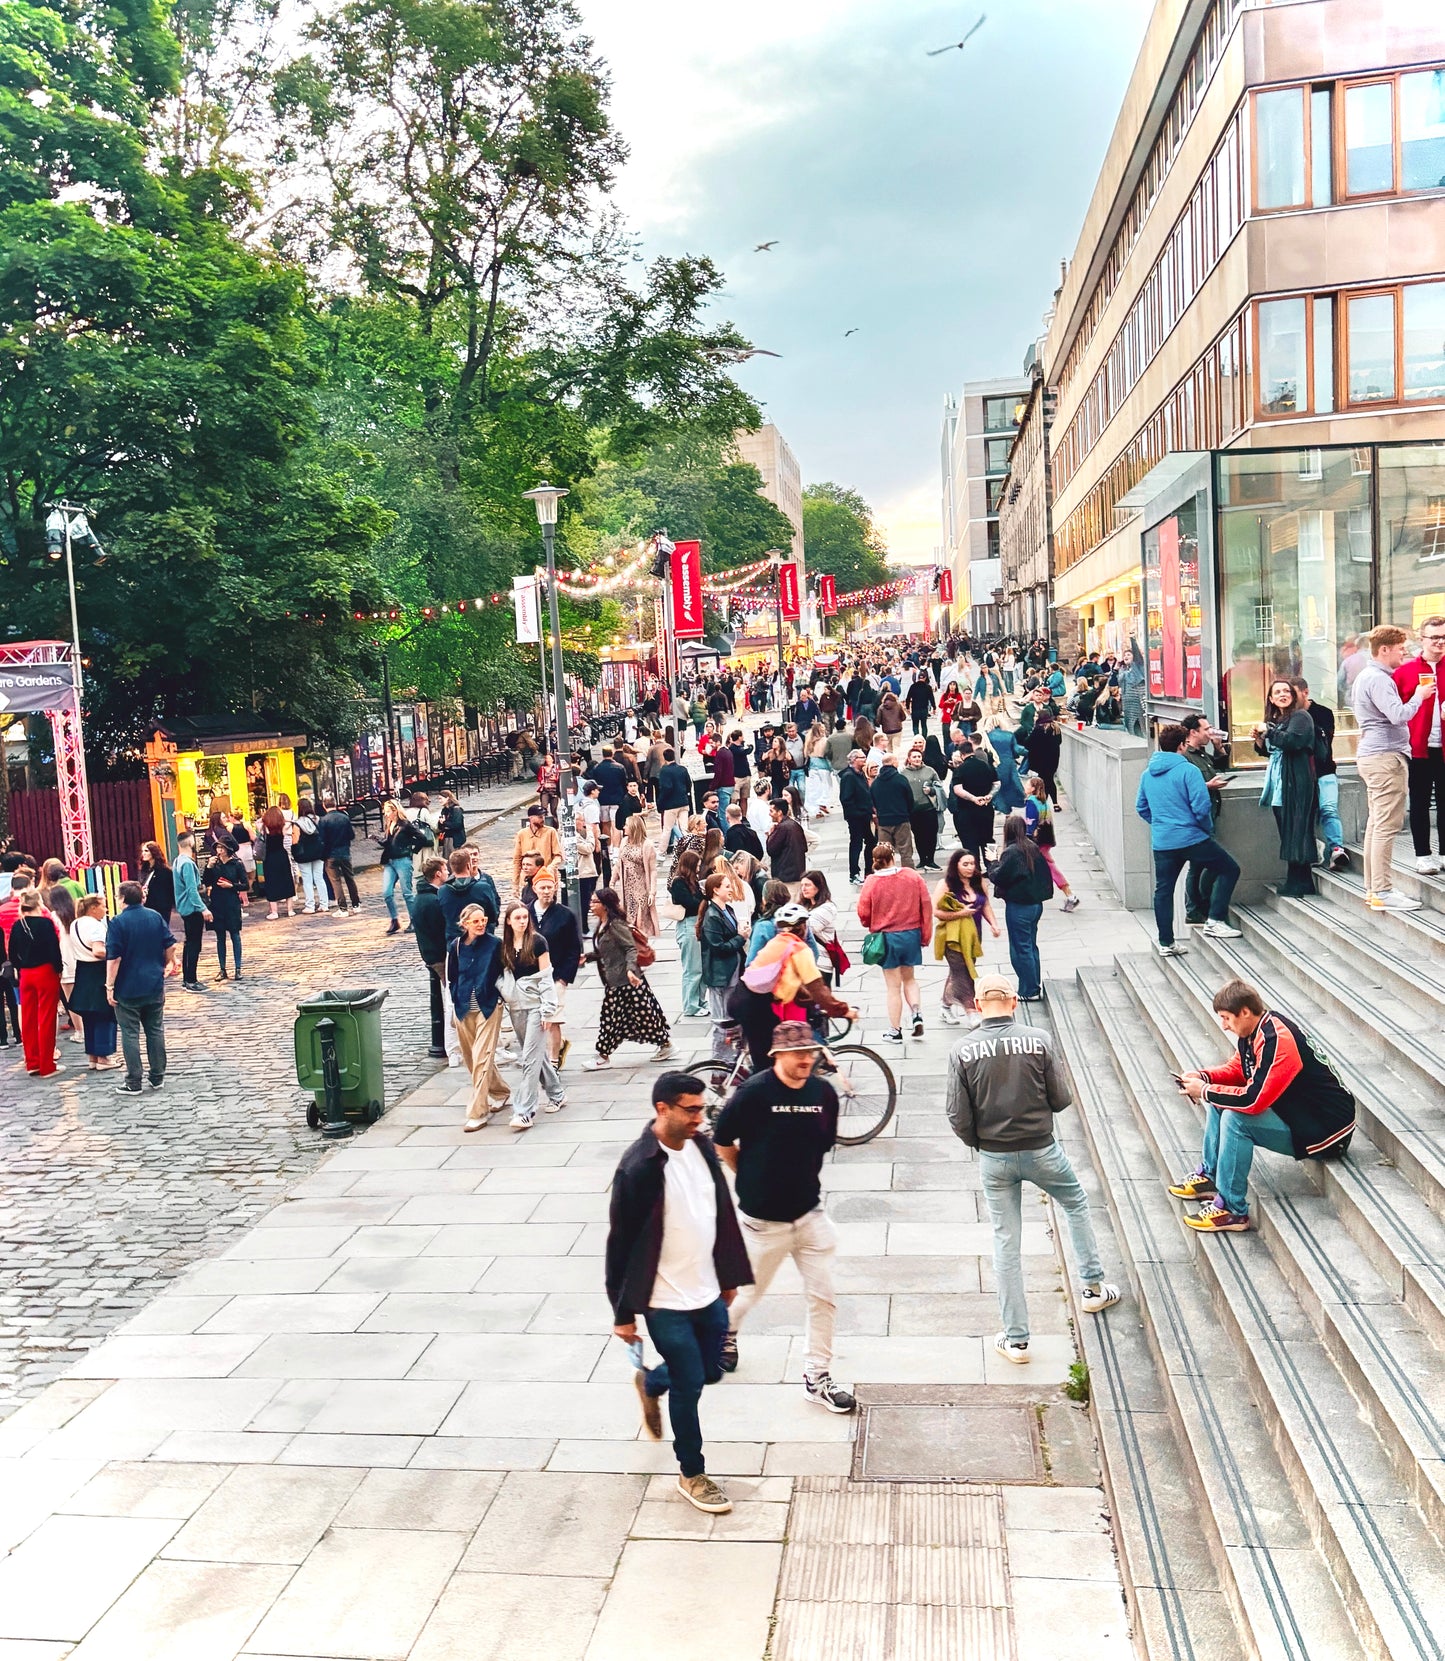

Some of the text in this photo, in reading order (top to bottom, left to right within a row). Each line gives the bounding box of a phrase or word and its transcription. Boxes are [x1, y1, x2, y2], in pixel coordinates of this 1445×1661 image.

[681, 563, 693, 611] assembly
[15, 674, 63, 687] Gardens
[960, 1036, 1044, 1063] STAY TRUE
